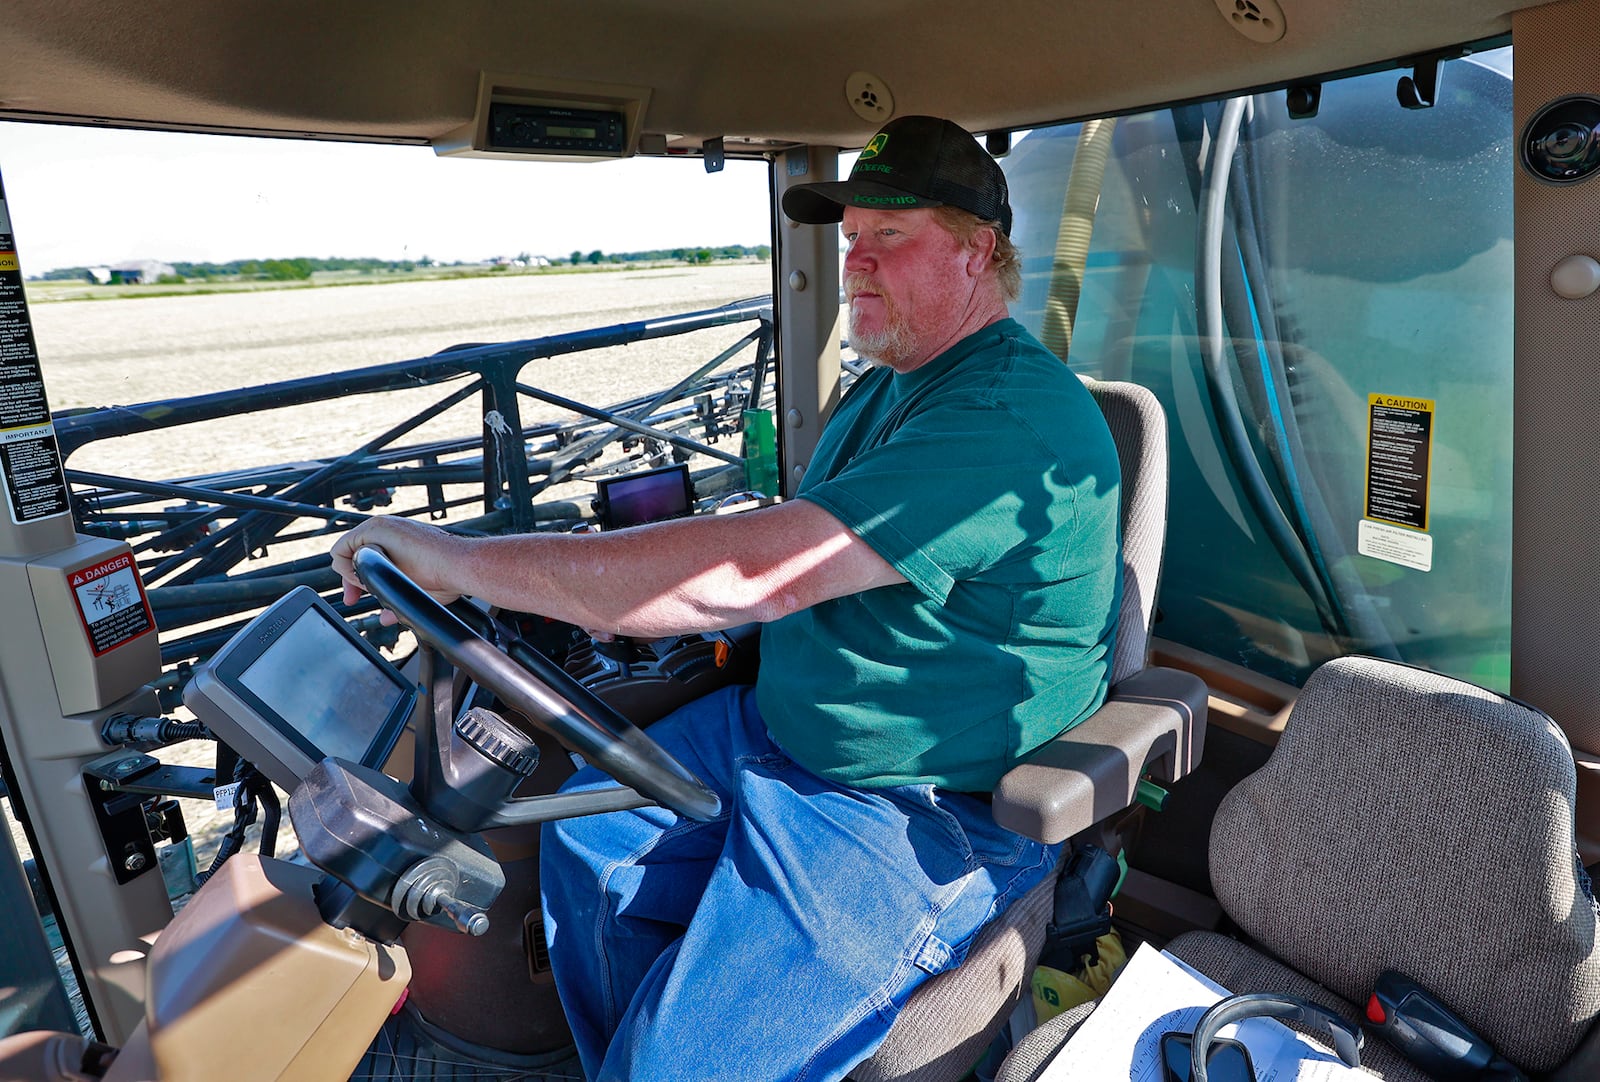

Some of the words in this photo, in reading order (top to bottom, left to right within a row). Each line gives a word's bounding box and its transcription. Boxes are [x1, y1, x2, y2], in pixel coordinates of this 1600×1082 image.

[860, 163, 893, 174] DEERE
[1386, 398, 1427, 410] CAUTION
[5, 429, 48, 440] IMPORTANT
[85, 557, 129, 579] DANGER
[92, 624, 108, 633] death
[125, 608, 144, 618] contact
[99, 615, 114, 624] avoid
[114, 609, 129, 618] injury
[94, 627, 114, 639] electric
[114, 621, 127, 629] lines
[128, 615, 141, 623] when
[95, 633, 117, 645] moving
[123, 619, 147, 633] operating
